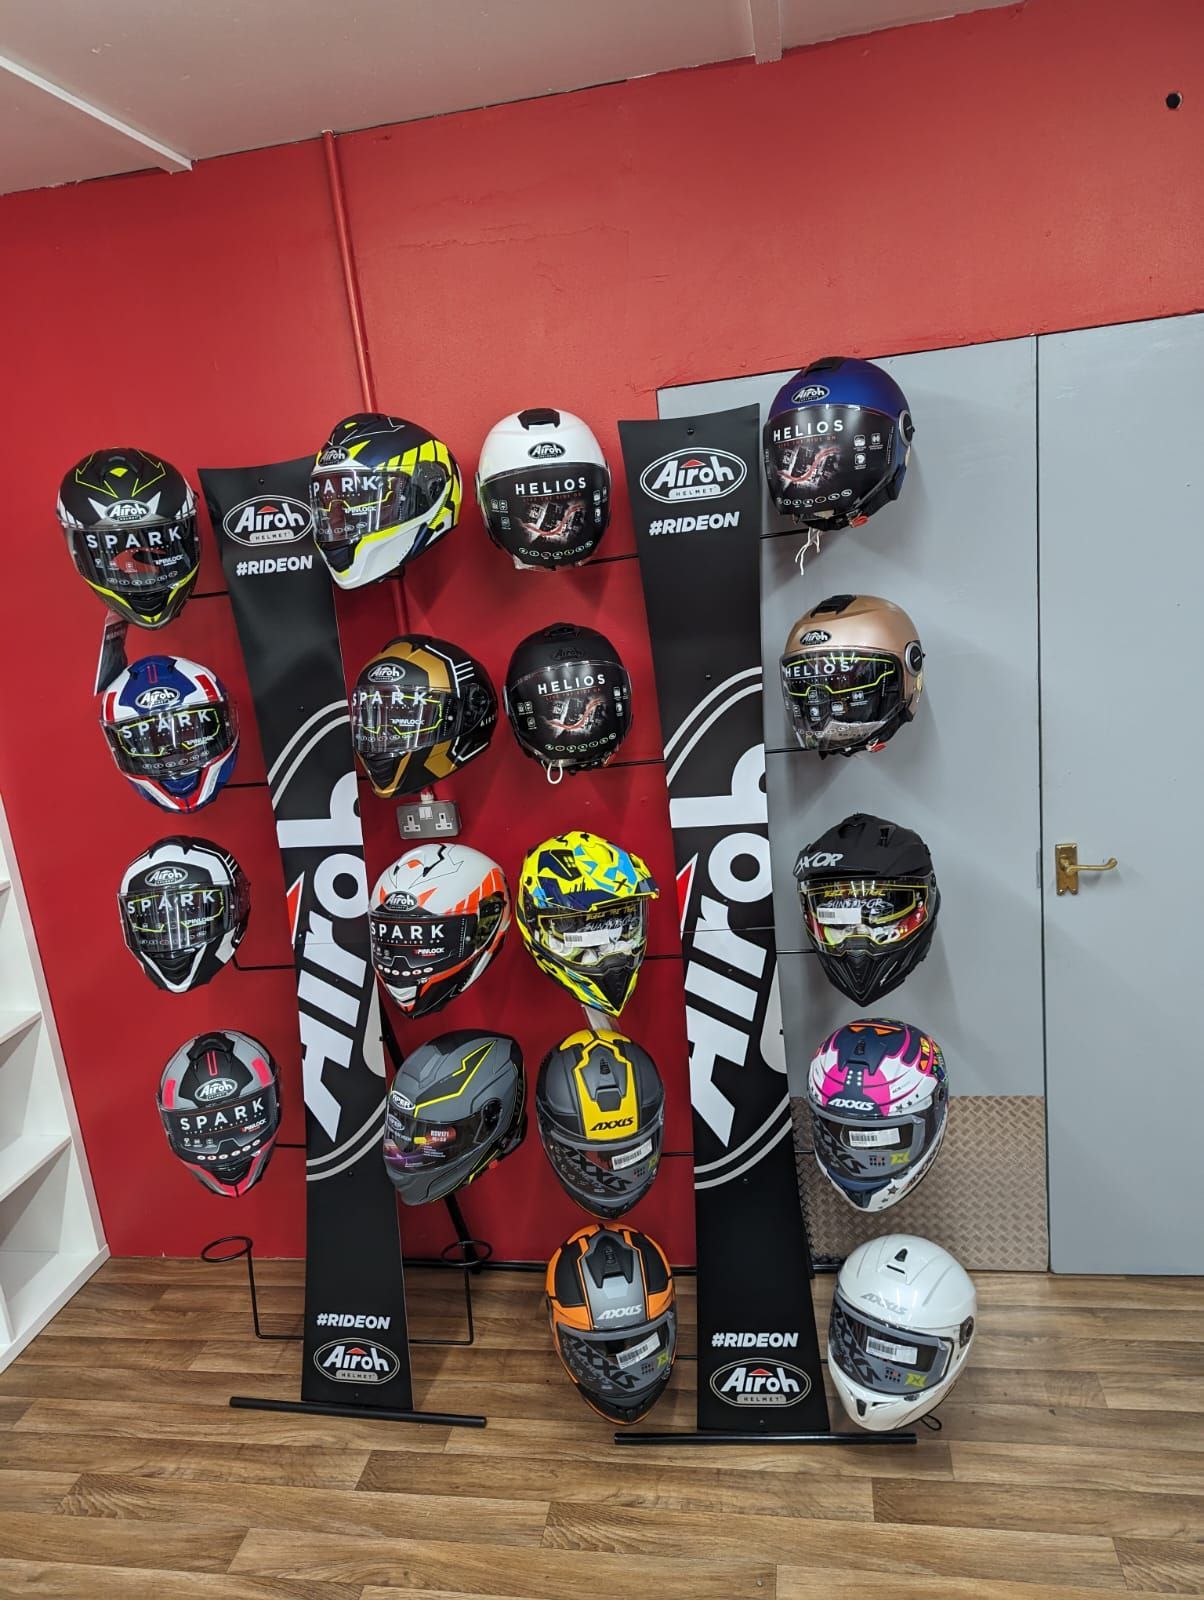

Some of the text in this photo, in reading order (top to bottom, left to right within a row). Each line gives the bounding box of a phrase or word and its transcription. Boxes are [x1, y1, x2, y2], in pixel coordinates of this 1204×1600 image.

[794, 387, 826, 401] Airoh
[773, 419, 844, 442] HELIOS
[319, 449, 346, 463] Airoh
[532, 443, 562, 456] Airoh
[651, 456, 735, 490] Airoh
[309, 477, 376, 499] PARK
[515, 477, 587, 495] HELIOS
[675, 487, 714, 497] HELMET
[109, 503, 147, 518] Airoh
[234, 501, 305, 533] Airoh
[649, 511, 740, 536] #RIDEON
[86, 526, 182, 549] SPARK
[254, 531, 291, 541] HELMET
[236, 555, 313, 576] #RIDEON
[370, 665, 400, 677] Airoh
[785, 661, 851, 678] HELIOS
[537, 674, 606, 695] HELIOS
[122, 710, 212, 739] SPARK
[148, 868, 183, 883] Airoh
[127, 891, 216, 914] SPARK
[385, 893, 415, 906] Airoh
[370, 922, 445, 939] SPARK
[199, 1080, 233, 1098] Airoh
[180, 1097, 265, 1131] SPARK
[316, 1312, 391, 1330] #RIDEON
[711, 1332, 799, 1348] #RIDEON
[322, 1345, 390, 1372] Airoh
[720, 1367, 800, 1393] Airoh
